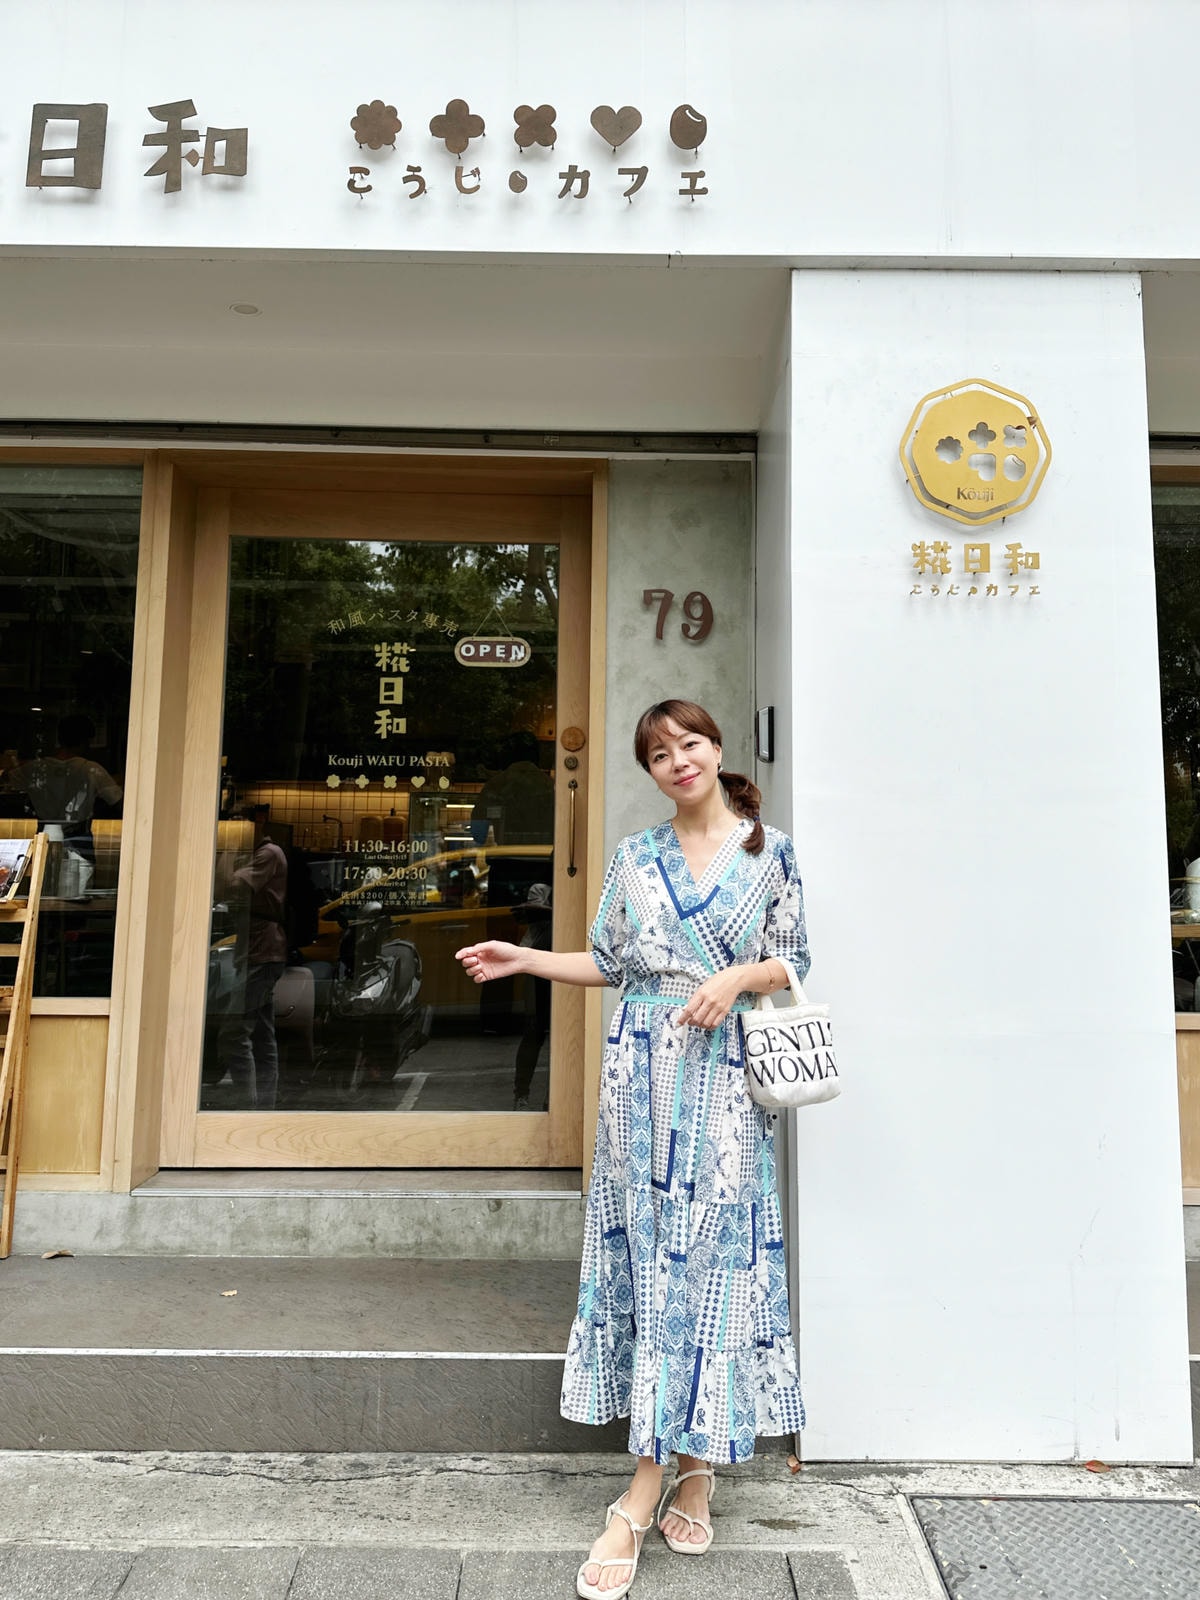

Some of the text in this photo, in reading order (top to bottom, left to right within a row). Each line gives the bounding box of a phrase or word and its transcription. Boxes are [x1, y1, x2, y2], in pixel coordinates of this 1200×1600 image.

[643, 589, 714, 641] 79
[461, 644, 525, 660] OPEN
[328, 755, 450, 768] Kouji WAFU PASTA
[345, 839, 428, 853] 11:30-16:00
[344, 866, 427, 880] 17:30-20:30
[746, 1021, 832, 1057] GENTL
